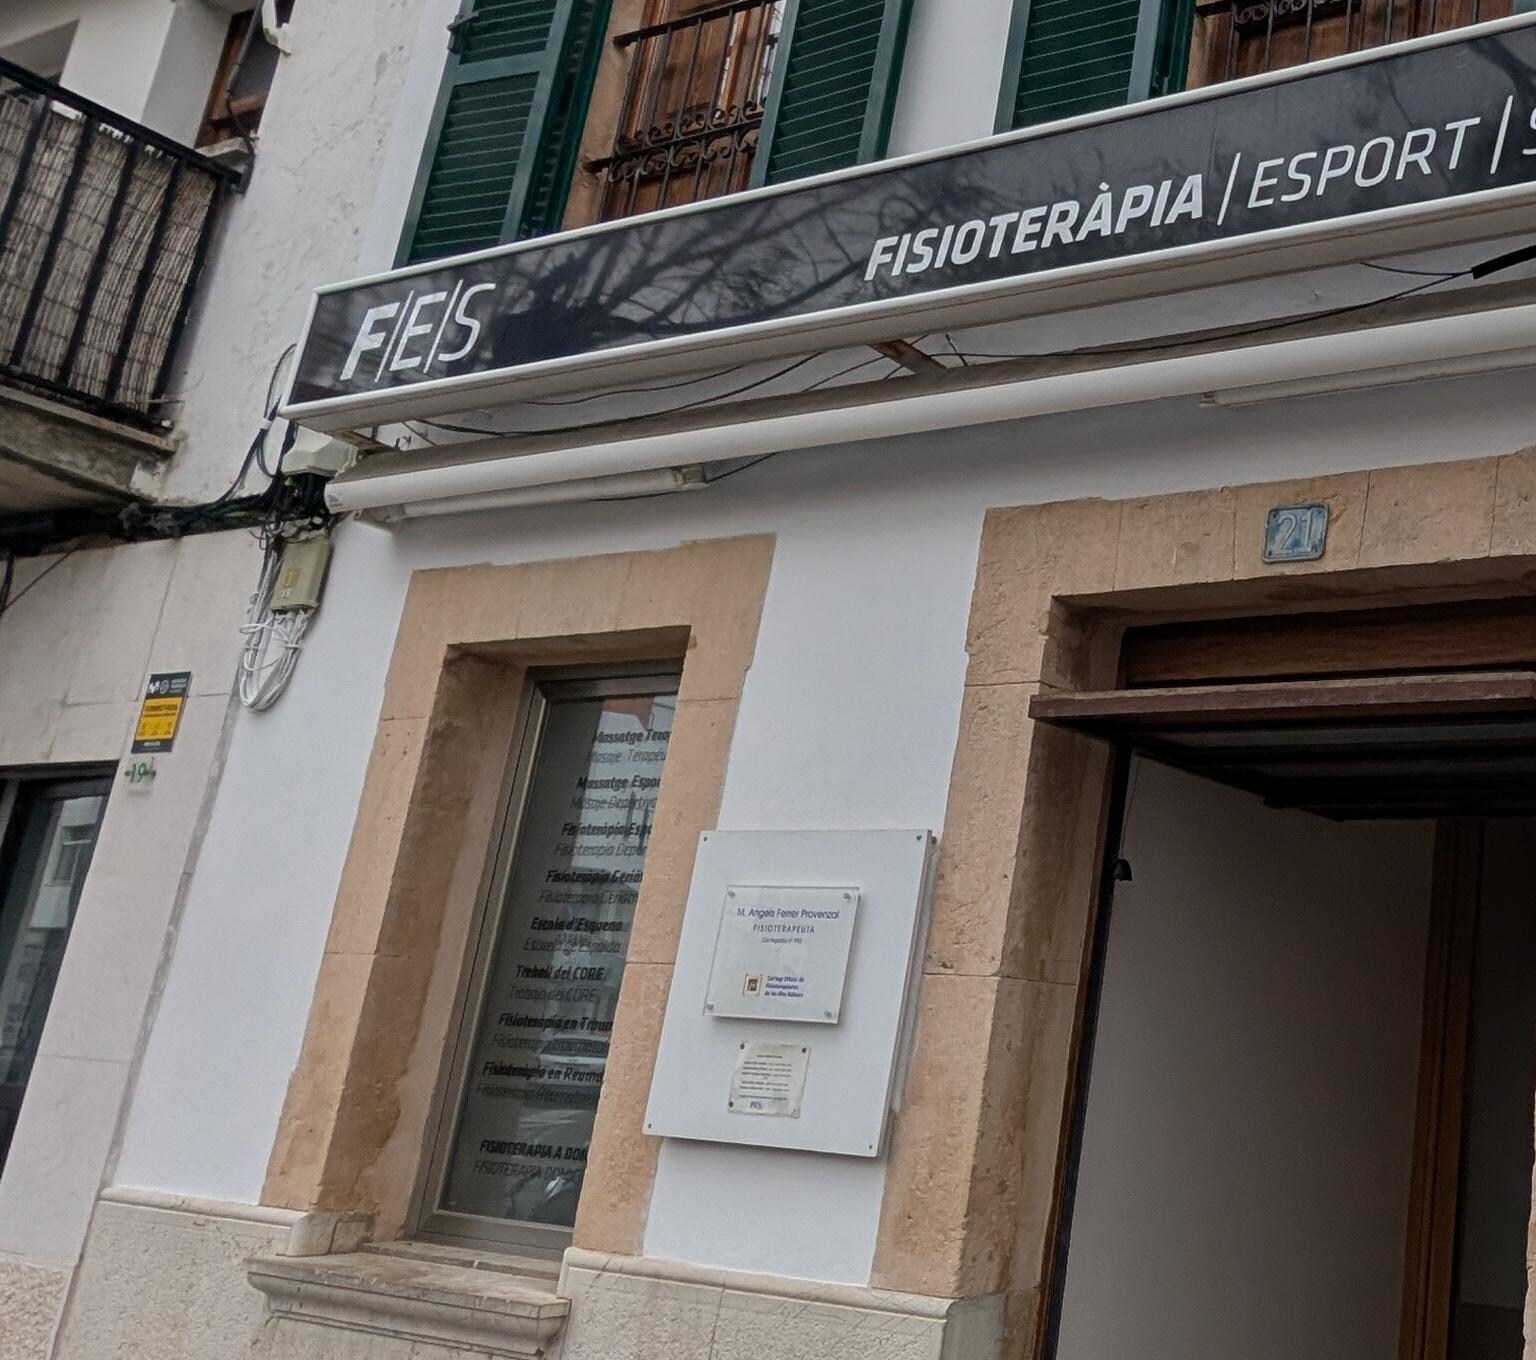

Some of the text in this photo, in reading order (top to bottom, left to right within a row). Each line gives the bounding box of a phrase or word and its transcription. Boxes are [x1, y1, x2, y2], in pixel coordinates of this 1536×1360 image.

[864, 173, 1204, 283] FISIOTERÀPIA
[1247, 117, 1481, 208] ESPORT
[1276, 507, 1313, 554] 21
[530, 916, 565, 931] Escola
[572, 966, 607, 981] CORE
